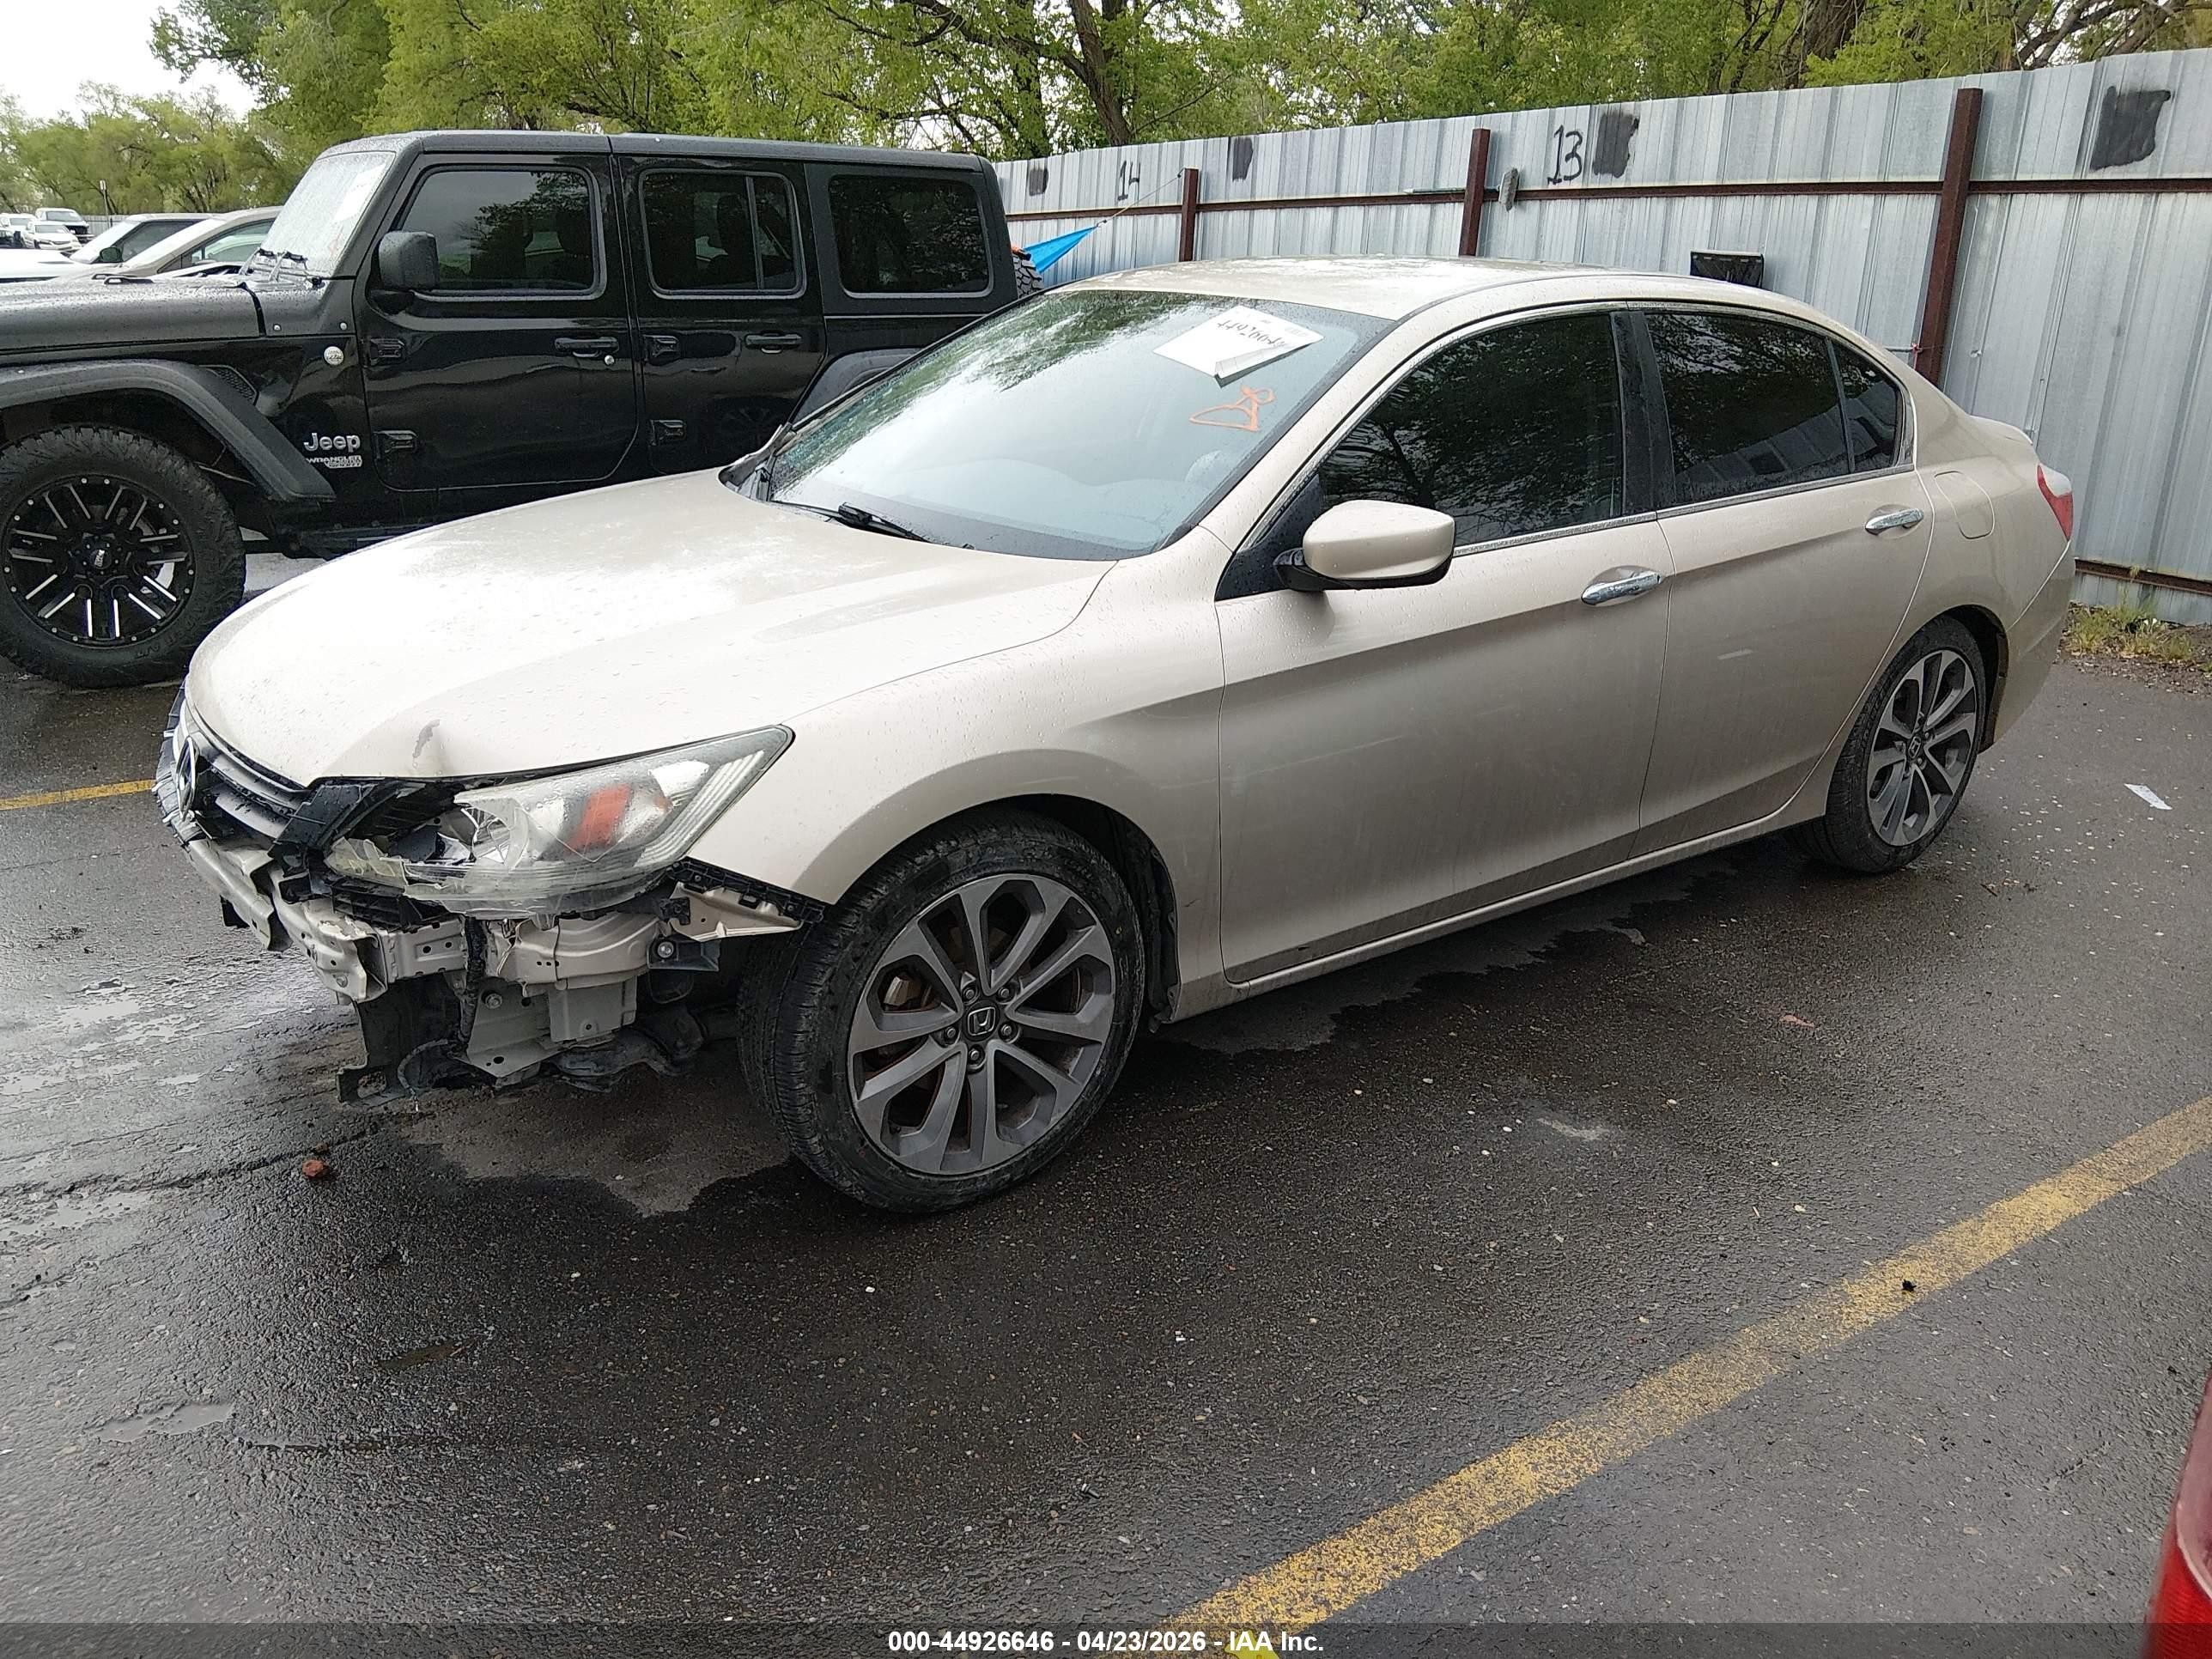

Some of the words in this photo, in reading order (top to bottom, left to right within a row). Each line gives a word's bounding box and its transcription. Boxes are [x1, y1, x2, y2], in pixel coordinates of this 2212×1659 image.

[1547, 125, 1583, 185] 13
[1117, 160, 1141, 203] 14
[303, 432, 361, 453] Jeep
